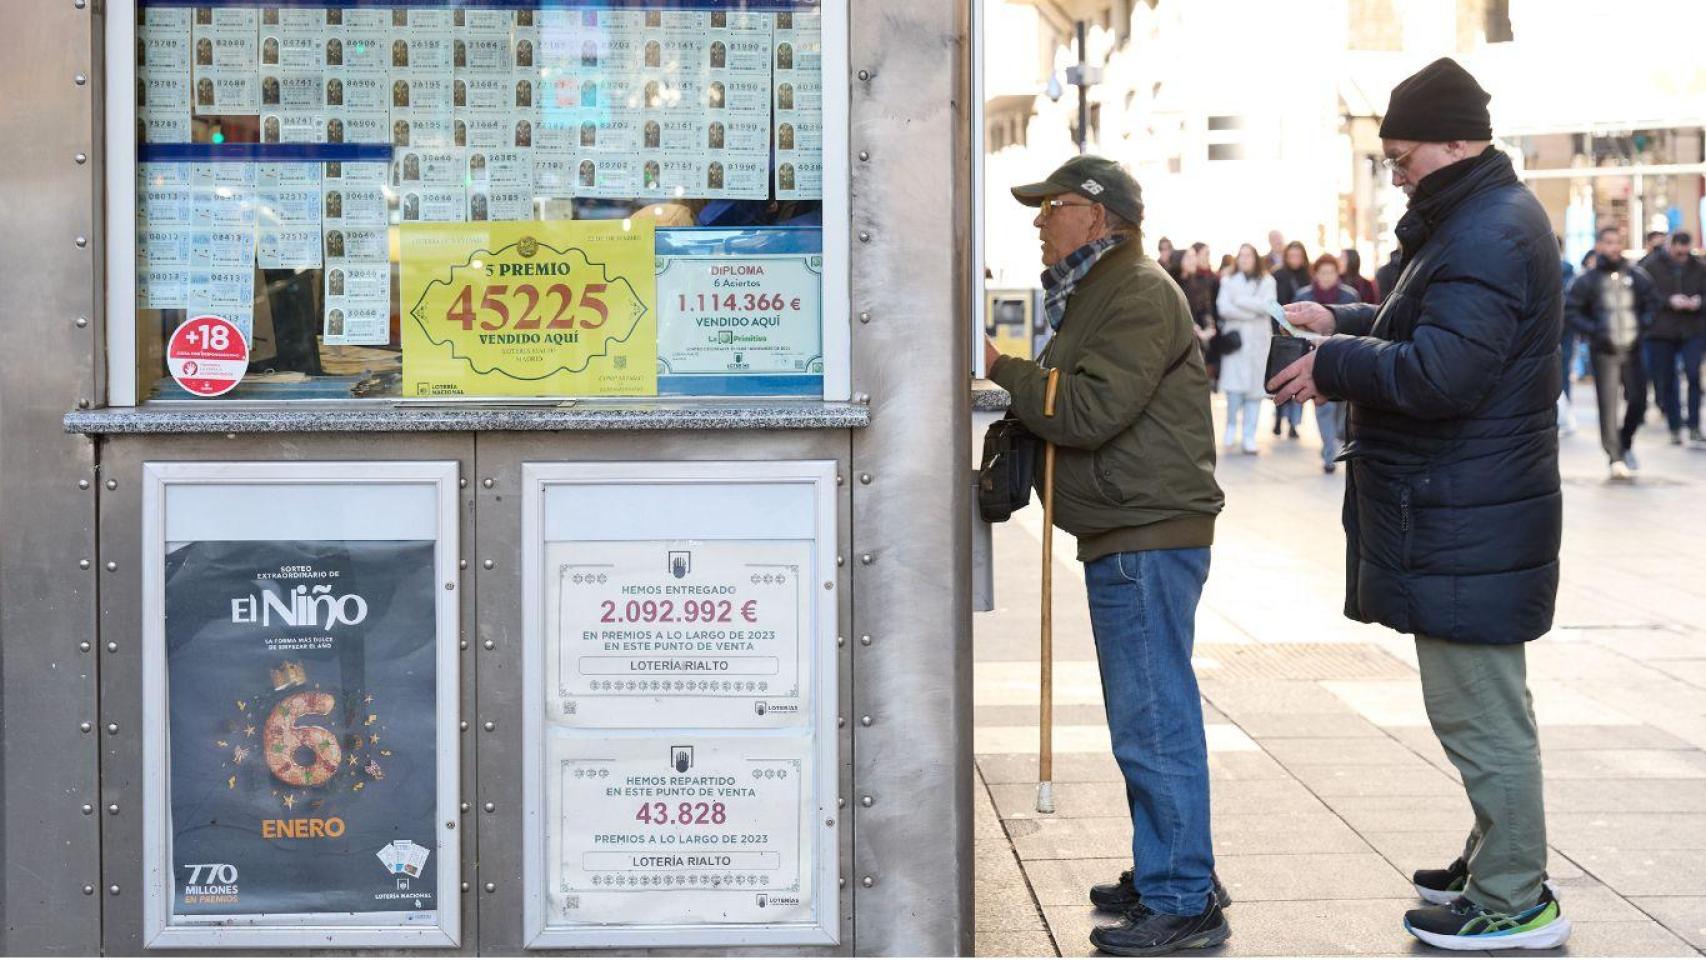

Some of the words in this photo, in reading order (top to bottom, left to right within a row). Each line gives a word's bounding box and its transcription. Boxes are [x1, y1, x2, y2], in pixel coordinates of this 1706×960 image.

[1081, 179, 1104, 195] 26
[485, 264, 494, 277] 5
[499, 262, 571, 276] PREMIO
[711, 265, 764, 276] DIPLOMA
[714, 279, 720, 287] 6
[723, 279, 761, 287] Aciertos
[446, 283, 609, 331] 45225
[678, 293, 785, 312] 1.114.366
[790, 298, 801, 311] €
[696, 317, 749, 327] VENDIDO
[751, 315, 780, 329] AQUÍ
[186, 325, 229, 350] +18
[479, 333, 541, 344] VENDIDO
[544, 331, 579, 345] AQUÍ
[733, 334, 767, 342] Primitiva
[257, 571, 327, 579] EXTRAORDINARIO
[622, 586, 662, 594] HEMOS
[666, 586, 736, 594] ENTREGADO
[262, 584, 368, 631] Niño
[600, 600, 732, 624] 2.092.992
[741, 600, 758, 623] €
[583, 631, 598, 640] EN
[602, 631, 652, 640] PREMIOS
[655, 631, 663, 640] A
[667, 631, 682, 640] LO
[685, 631, 726, 640] LARGO
[729, 631, 744, 640] DE
[747, 631, 775, 640] 2023
[604, 642, 619, 651] EN
[623, 642, 650, 651] ESTE
[654, 642, 693, 651] PUNTO
[697, 642, 712, 651] DE
[716, 642, 754, 651] VENTA
[630, 659, 681, 671] LOTERÍA
[685, 660, 729, 671] RIALTO
[263, 691, 342, 787] 6
[626, 777, 666, 785] HEMOS
[670, 777, 736, 785] REPARTIDO
[606, 788, 622, 796] EN
[626, 788, 653, 796] ESTE
[656, 788, 695, 796] PUNTO
[700, 788, 714, 796] DE
[718, 788, 756, 797] VENTA
[636, 802, 726, 825] 43.828
[262, 817, 346, 839] ENERO
[595, 835, 645, 844] PREMIOS
[649, 835, 657, 844] A
[660, 835, 676, 844] LO
[679, 835, 718, 844] LARGO
[722, 835, 738, 844] DE
[741, 835, 768, 844] 2023
[633, 855, 684, 867] LOTERÍA
[687, 857, 731, 867] RIALTO
[184, 864, 238, 885] 770
[185, 885, 239, 895] MILLONES
